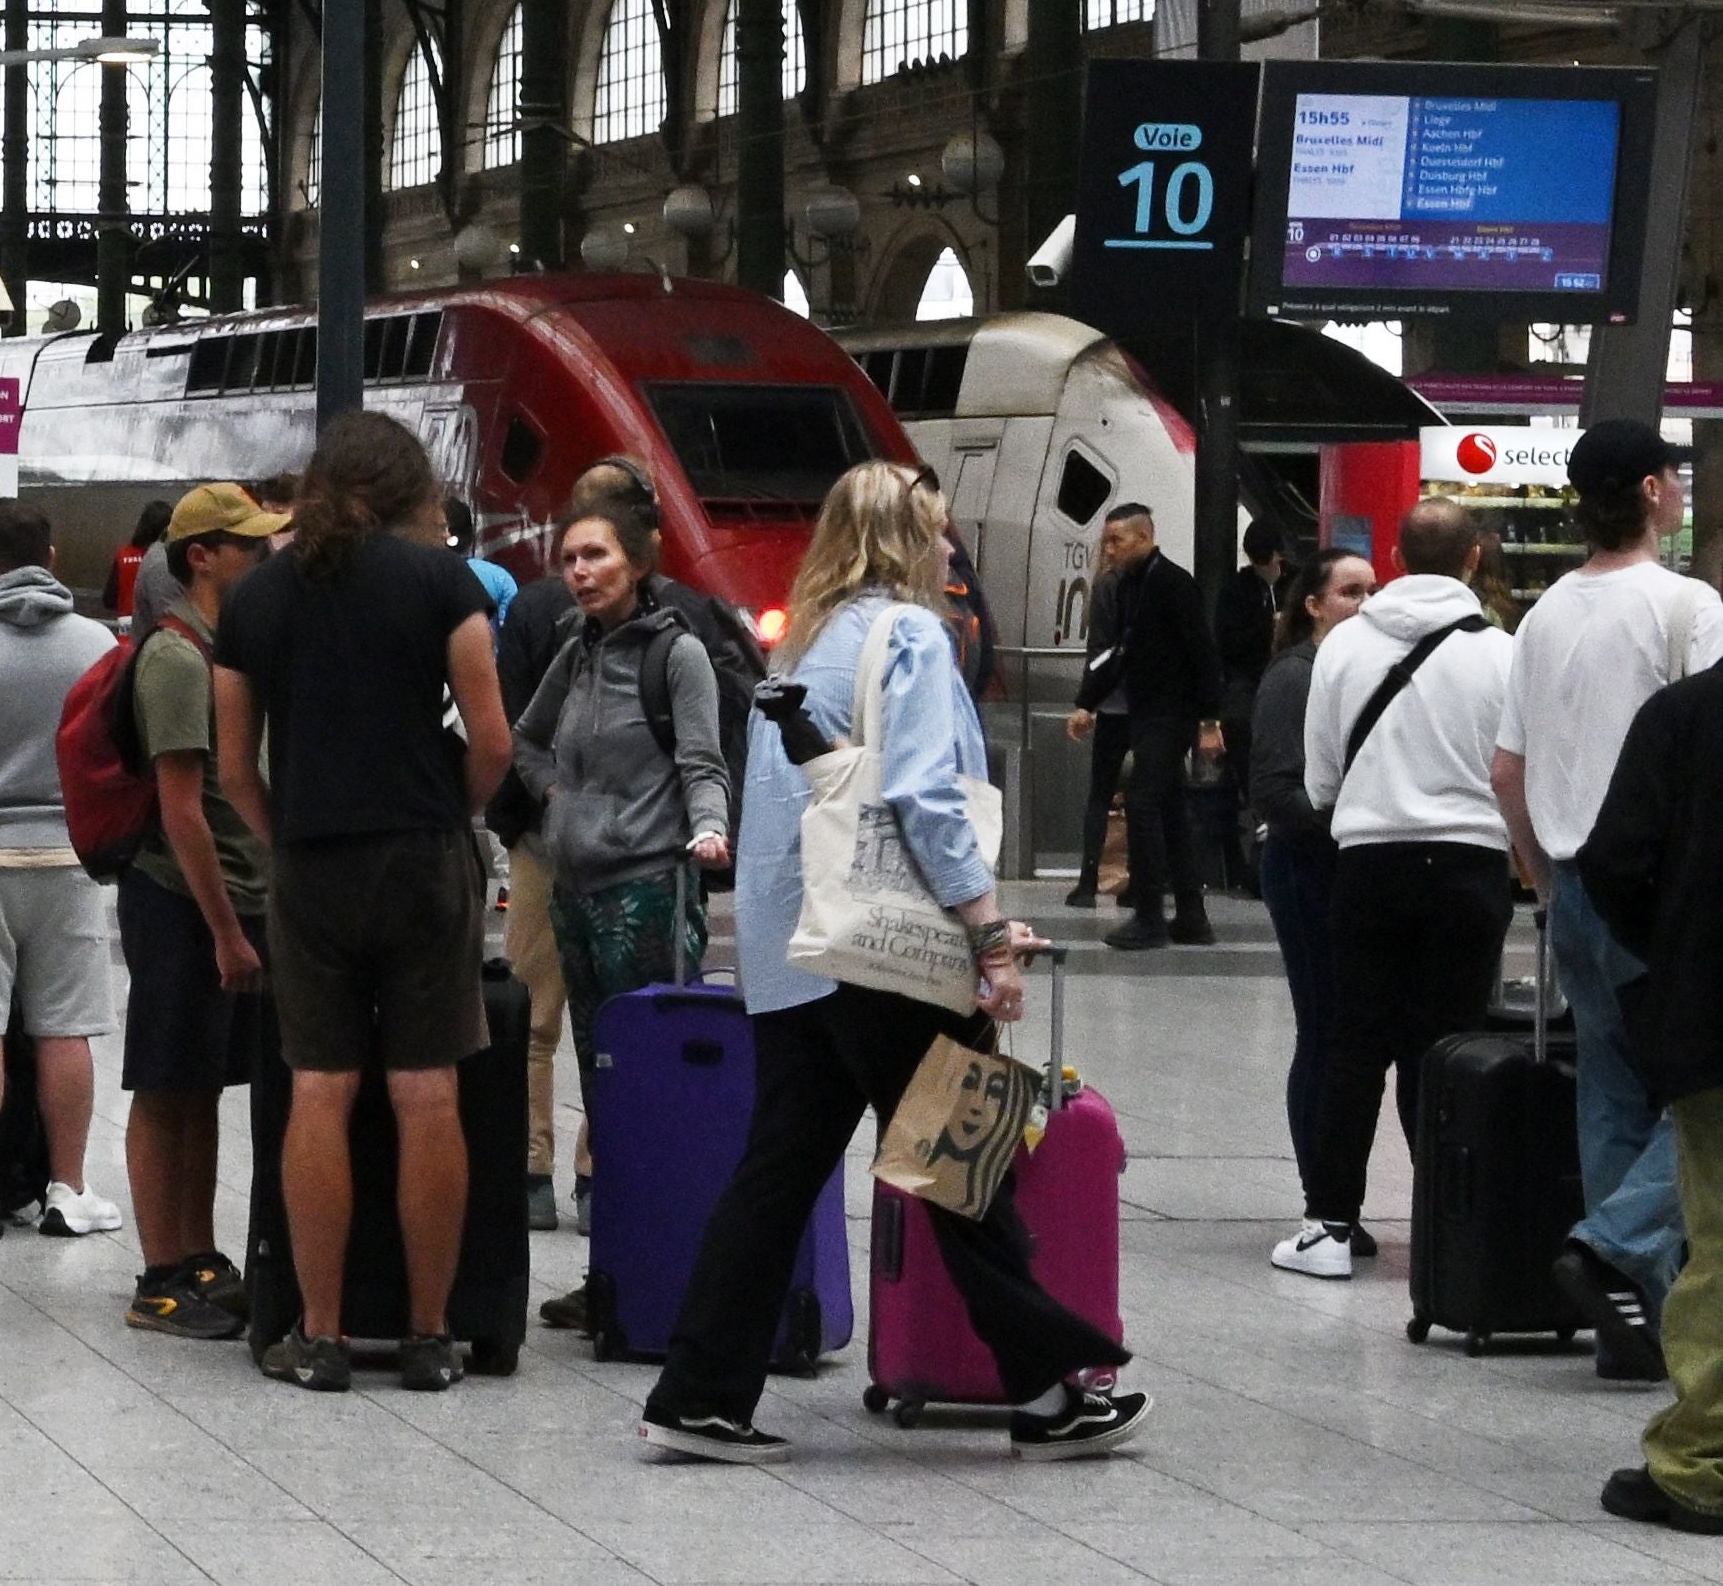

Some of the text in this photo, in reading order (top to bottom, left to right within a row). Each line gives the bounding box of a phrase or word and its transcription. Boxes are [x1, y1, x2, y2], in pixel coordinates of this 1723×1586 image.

[1299, 111, 1350, 125] 15h55
[1143, 127, 1192, 147] Voie
[1296, 134, 1384, 146] Bruxelles Midi
[1294, 163, 1355, 174] Essen Hbf
[1117, 161, 1214, 235] 10
[1288, 228, 1304, 242] 10
[1064, 542, 1094, 570] TGV
[852, 919, 890, 953] and
